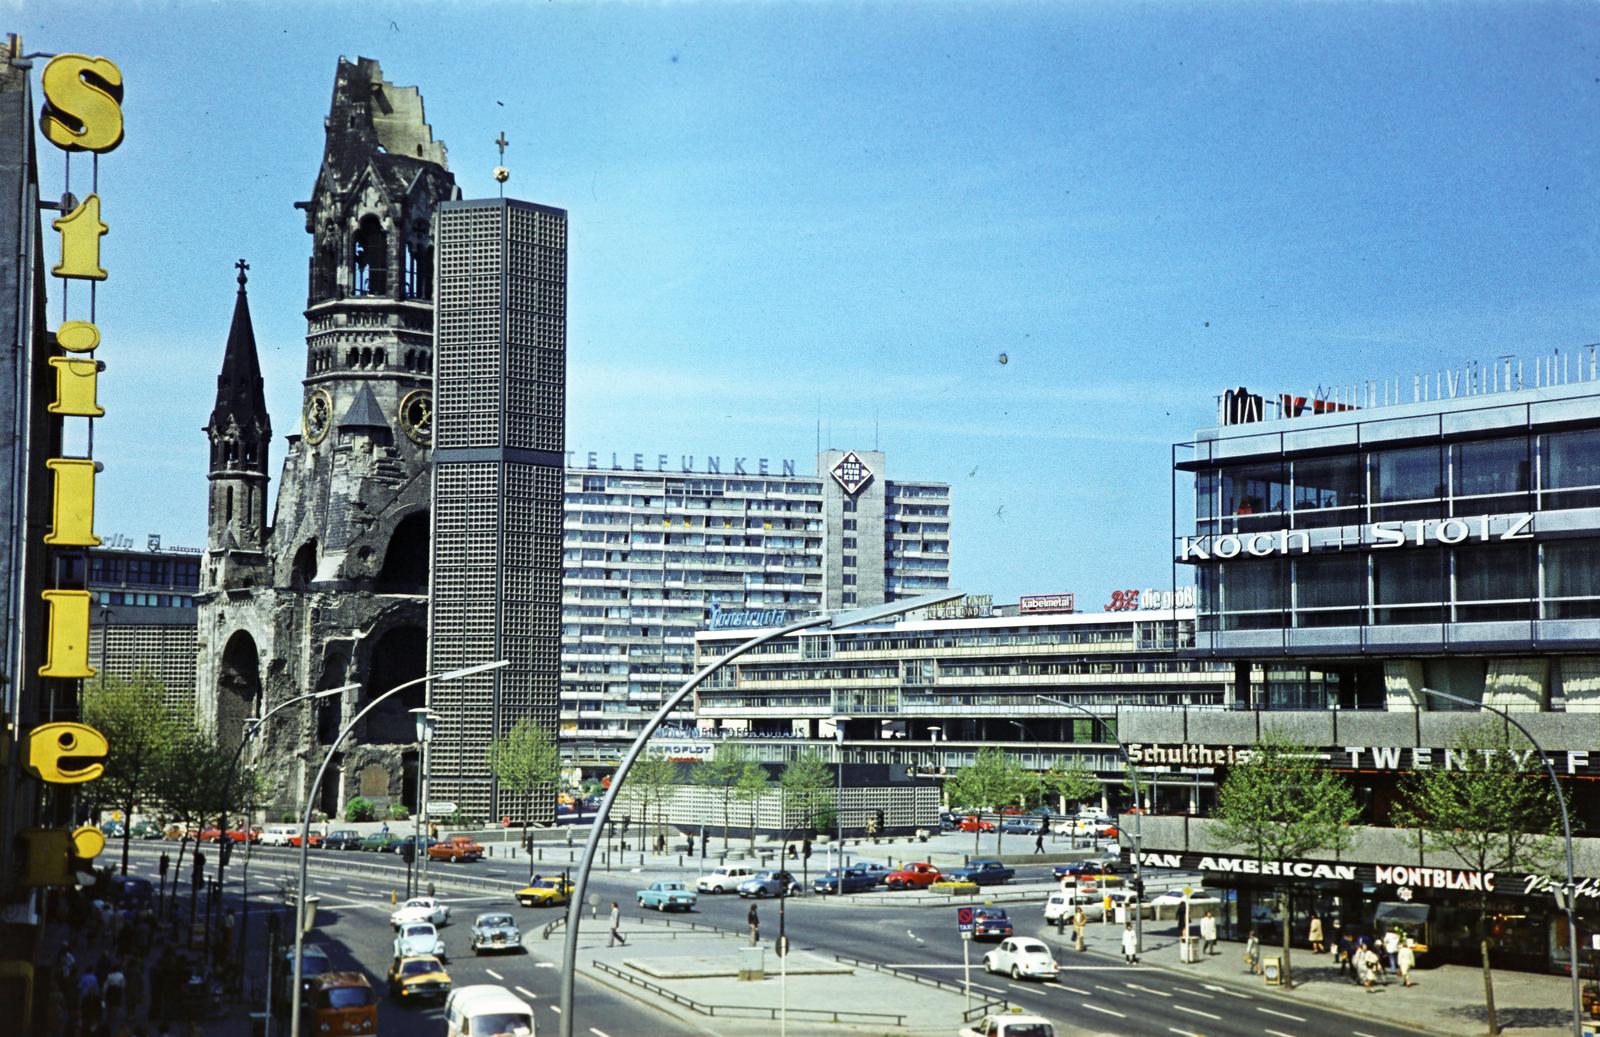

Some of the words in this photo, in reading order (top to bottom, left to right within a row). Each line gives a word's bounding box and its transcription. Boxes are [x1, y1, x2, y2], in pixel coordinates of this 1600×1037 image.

[564, 451, 794, 476] TELEFUNKEN
[1130, 852, 1182, 868] PAN
[1198, 856, 1356, 880] AMERICAN
[1375, 864, 1494, 891] MONTBLANC
